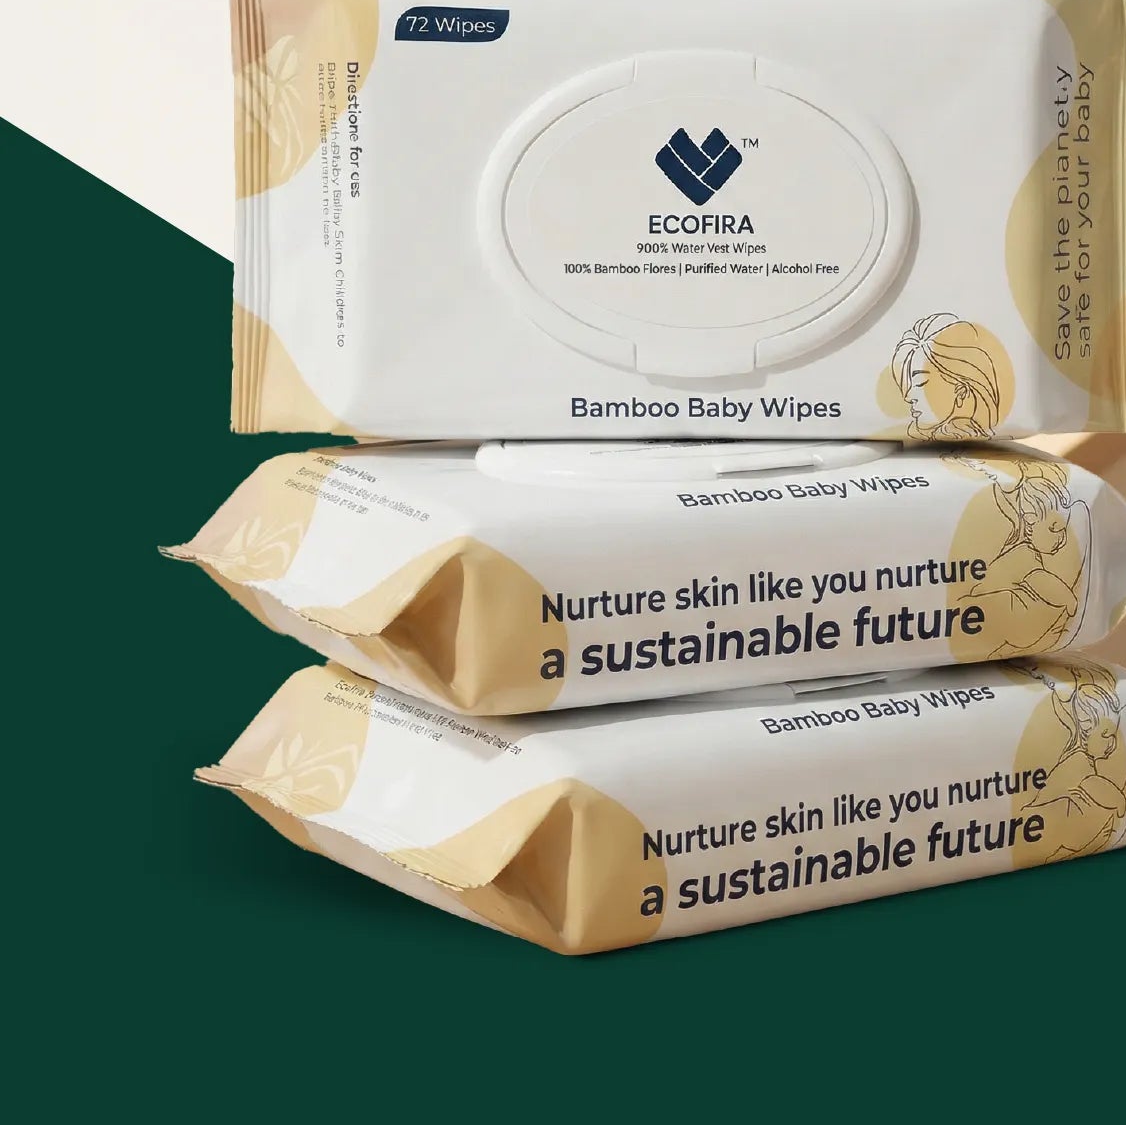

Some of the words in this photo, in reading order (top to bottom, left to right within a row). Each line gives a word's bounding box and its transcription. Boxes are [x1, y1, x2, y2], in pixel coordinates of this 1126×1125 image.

[405, 15, 430, 33] 72
[434, 15, 497, 38] Wipes
[1072, 61, 1095, 143] baby
[1077, 154, 1093, 229] your
[636, 242, 669, 255] 900%
[671, 242, 705, 255] Water
[706, 242, 731, 255] Vest
[732, 241, 767, 257] Wipes
[648, 214, 755, 235] ECOFIRA
[1052, 216, 1071, 274] the
[563, 263, 592, 275] 100%
[594, 262, 641, 275] Bamboo
[643, 262, 677, 275] Flores
[684, 262, 728, 275] Purified
[730, 262, 764, 275] Water
[771, 262, 813, 275] Alcohol
[815, 262, 840, 275] Free
[1073, 238, 1091, 283] for
[1054, 283, 1072, 362] Save
[570, 396, 680, 418] Bamboo
[687, 396, 753, 423] Baby
[760, 395, 842, 422] Wipes
[676, 487, 784, 508] Bamboo
[784, 480, 849, 499] Baby
[849, 474, 930, 495] Wipes
[541, 589, 667, 624] Nurture
[675, 578, 739, 611] skin
[748, 570, 802, 604] like
[811, 569, 866, 606] you
[874, 557, 988, 591] nurture
[540, 646, 566, 681] a
[580, 611, 842, 677] sustainable
[852, 604, 986, 648] future
[759, 708, 862, 735] Bamboo
[860, 698, 922, 718] Baby
[920, 685, 997, 710] Wipes
[641, 818, 758, 861] Nurture
[764, 800, 825, 840] skin
[833, 792, 882, 827] like
[887, 792, 939, 824] you
[947, 766, 1048, 808] nurture
[639, 882, 665, 917] a
[678, 831, 916, 910] sustainable
[927, 812, 1046, 863] future
